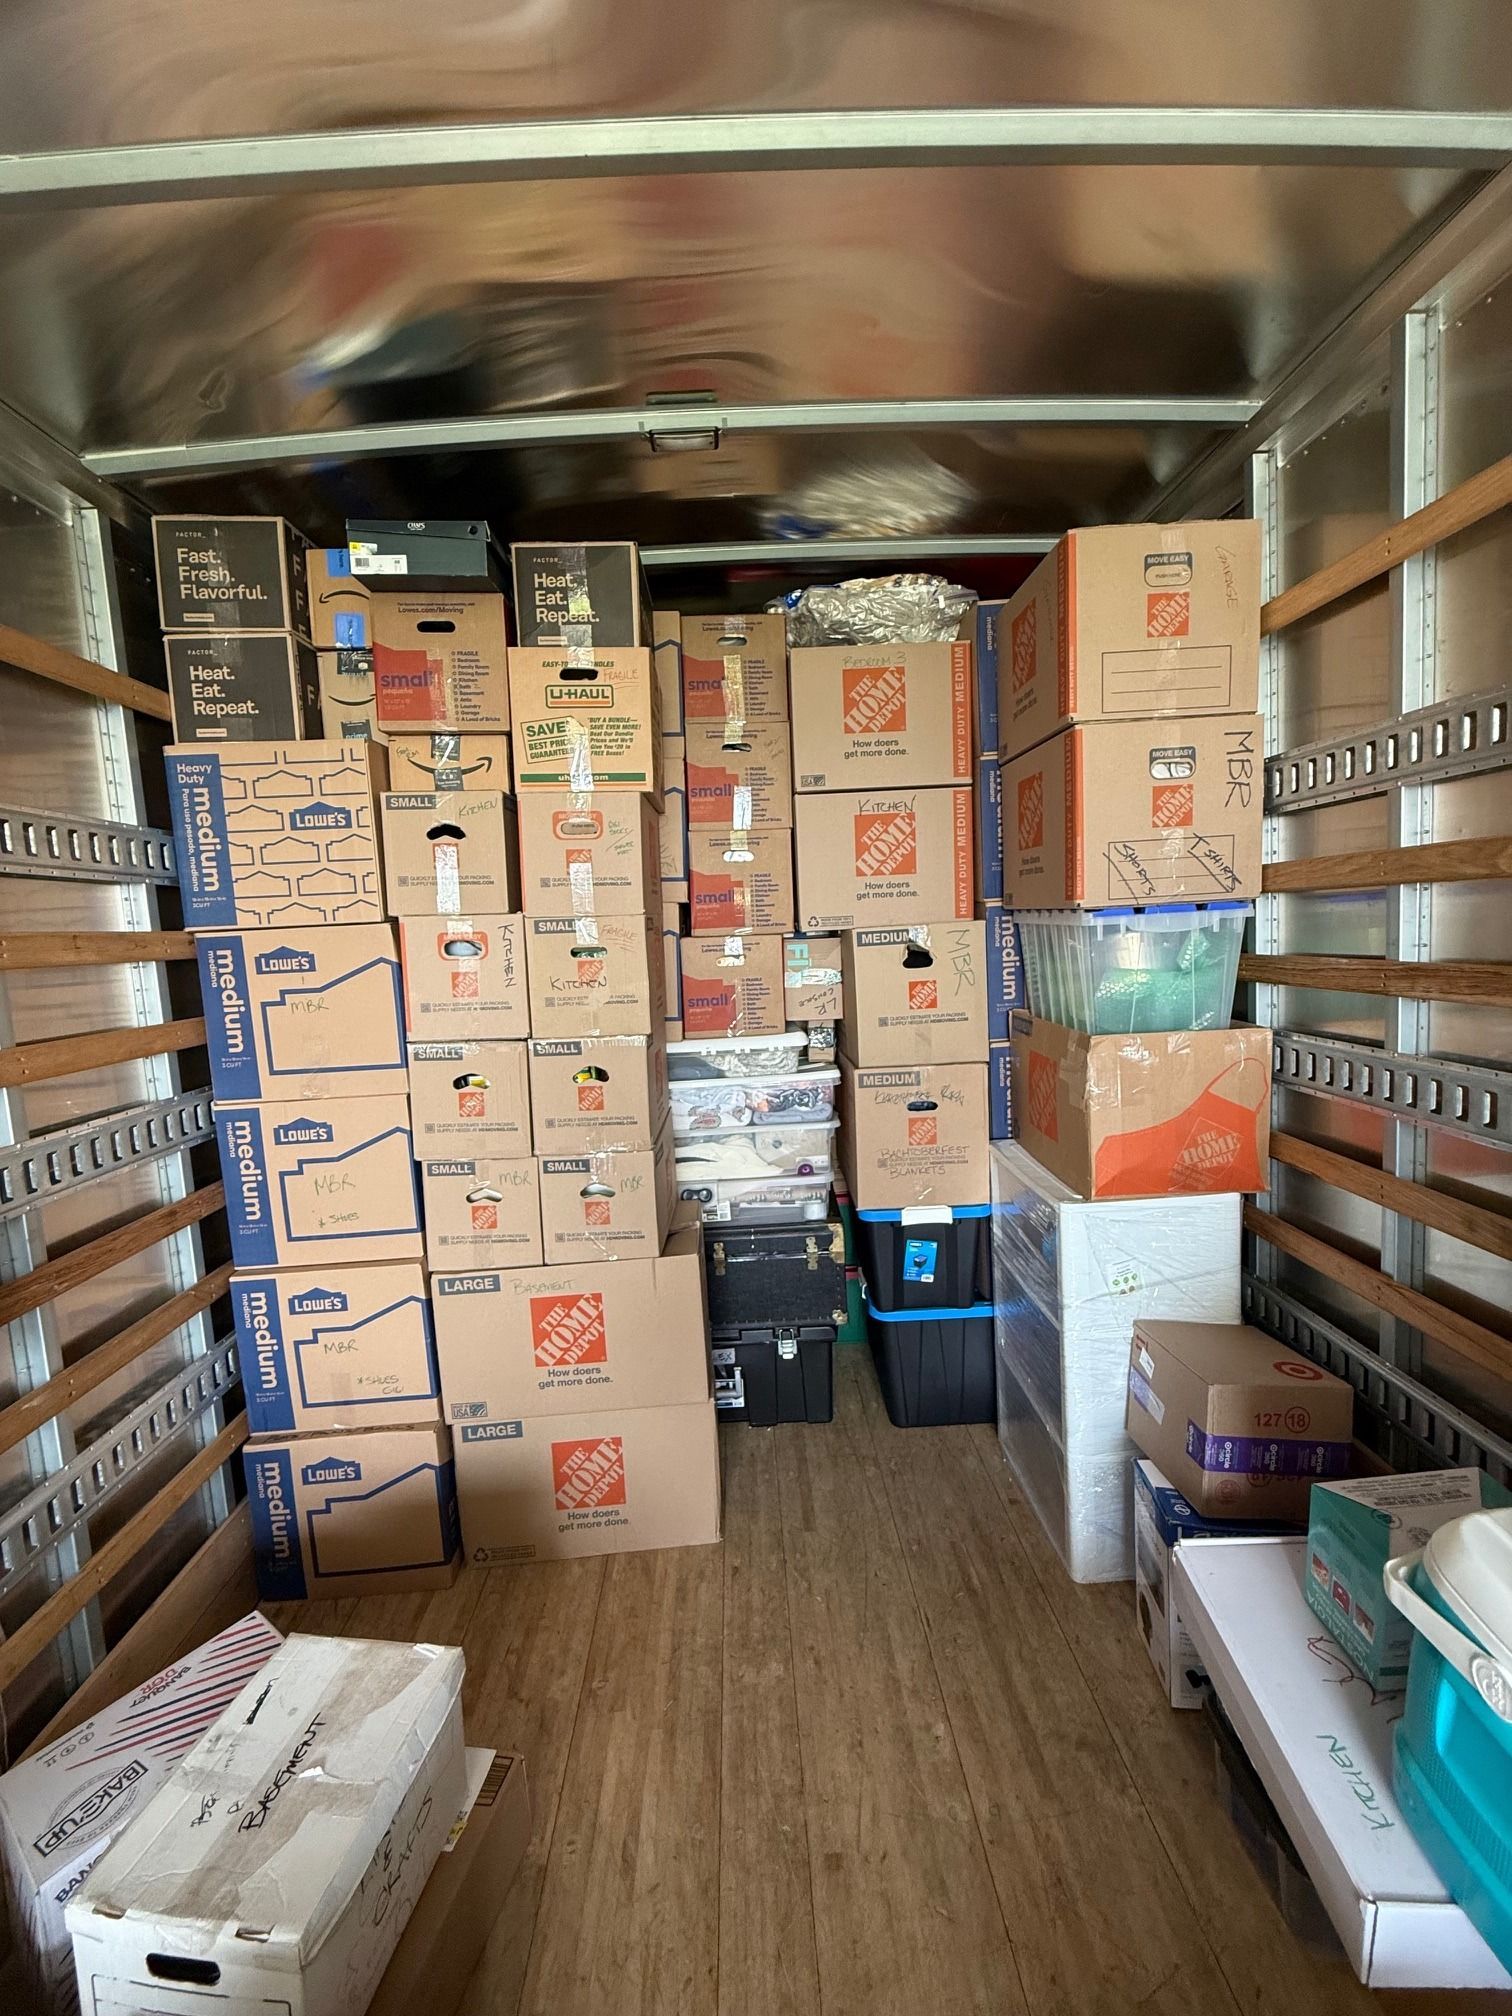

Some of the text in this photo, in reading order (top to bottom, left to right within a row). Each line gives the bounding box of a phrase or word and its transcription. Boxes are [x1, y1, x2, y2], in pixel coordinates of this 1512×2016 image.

[177, 548, 222, 564] Fast.
[1147, 555, 1189, 564] MOVE EASY
[178, 566, 236, 584] Fresh.
[534, 573, 577, 588] Heat.
[180, 584, 268, 600] Flavorful.
[535, 590, 567, 605] Eat.
[536, 608, 600, 626] Repeat.
[1148, 592, 1190, 638] HOME
[896, 651, 907, 664] 3
[190, 665, 236, 681] Heat.
[192, 684, 226, 698] Eat.
[550, 688, 610, 700] U-HAUL
[849, 674, 876, 702] THE
[843, 667, 906, 734] HOME
[953, 645, 965, 774] HEAVY DUTY MEDIUM
[194, 701, 260, 719] Repeat.
[866, 690, 907, 734] DEPOT
[528, 741, 548, 751] BEST
[852, 738, 899, 748] How doers
[844, 747, 910, 760] get more done.
[1152, 749, 1193, 758] MOVE EASY
[176, 764, 213, 777] Heavy
[1224, 730, 1255, 808] MBR
[178, 774, 205, 785] Duty
[181, 789, 190, 807] Para
[690, 784, 732, 798] small
[1156, 791, 1173, 807] THE
[390, 797, 433, 808] SMALL
[458, 797, 499, 819] KITCHEN
[857, 794, 917, 817] KITCHEN
[1152, 784, 1194, 828] HOME
[183, 807, 191, 822] uso
[296, 812, 347, 828] LOWE'S
[1169, 801, 1194, 827] DEPOT
[193, 787, 222, 892] medium
[860, 820, 887, 847] THE
[856, 812, 916, 877] HOME
[878, 835, 917, 876] DEPOT
[956, 793, 968, 916] HEAVY DUTY MEDIUM
[189, 856, 199, 892] mediana
[1114, 843, 1156, 896] SHORTS
[864, 880, 911, 890] How doers
[695, 889, 735, 904] small
[856, 889, 920, 901] get more done.
[538, 920, 577, 932] SMALL
[261, 956, 310, 972] LOWE'S
[497, 923, 517, 988] KITCHEN
[946, 929, 976, 997] MBR
[1001, 915, 1020, 1001] medium
[207, 950, 218, 988] mediana
[549, 975, 608, 992] KITCHEN
[217, 949, 246, 1054] medium
[290, 996, 330, 1015] MBR
[688, 994, 729, 1008] small
[418, 1049, 460, 1059] SMALL
[538, 1043, 578, 1055] SMALL
[863, 1073, 915, 1086] MEDIUM
[226, 1121, 236, 1158] mediana
[280, 1127, 328, 1142] LOWE'S
[1183, 1133, 1241, 1165] HOME
[235, 1120, 263, 1221] medium
[431, 1164, 472, 1174] SMALL
[547, 1161, 587, 1172] SMALL
[890, 1165, 946, 1179] BLANKETS
[314, 1172, 357, 1196] MBR
[444, 1278, 495, 1292] LARGE
[241, 1293, 252, 1329] mediana
[294, 1296, 343, 1312] LOWE'S
[538, 1302, 569, 1332] THE
[534, 1293, 605, 1367] HOME
[250, 1292, 278, 1389] medium
[324, 1338, 359, 1355] MBR
[562, 1318, 606, 1365] DEPOT
[548, 1366, 601, 1378] How doers
[538, 1375, 614, 1390] get more done.
[1254, 1412, 1306, 1428] 127 18
[467, 1423, 517, 1440] LARGE
[559, 1447, 589, 1476] THE
[255, 1463, 265, 1500] mediana
[307, 1466, 356, 1482] LOWE'S
[555, 1437, 623, 1510] HOME
[583, 1461, 625, 1508] DEPOT
[263, 1461, 292, 1559] medium
[567, 1508, 620, 1521] How doers
[558, 1522, 575, 1533] get
[577, 1520, 602, 1530] more
[129, 1666, 192, 1709] BANQUET
[139, 1667, 179, 1694] D'OR
[237, 1713, 327, 1835] BASEMENT
[1314, 1734, 1396, 1831] KITCHEN
[44, 1767, 141, 1849] BAKE'UP
